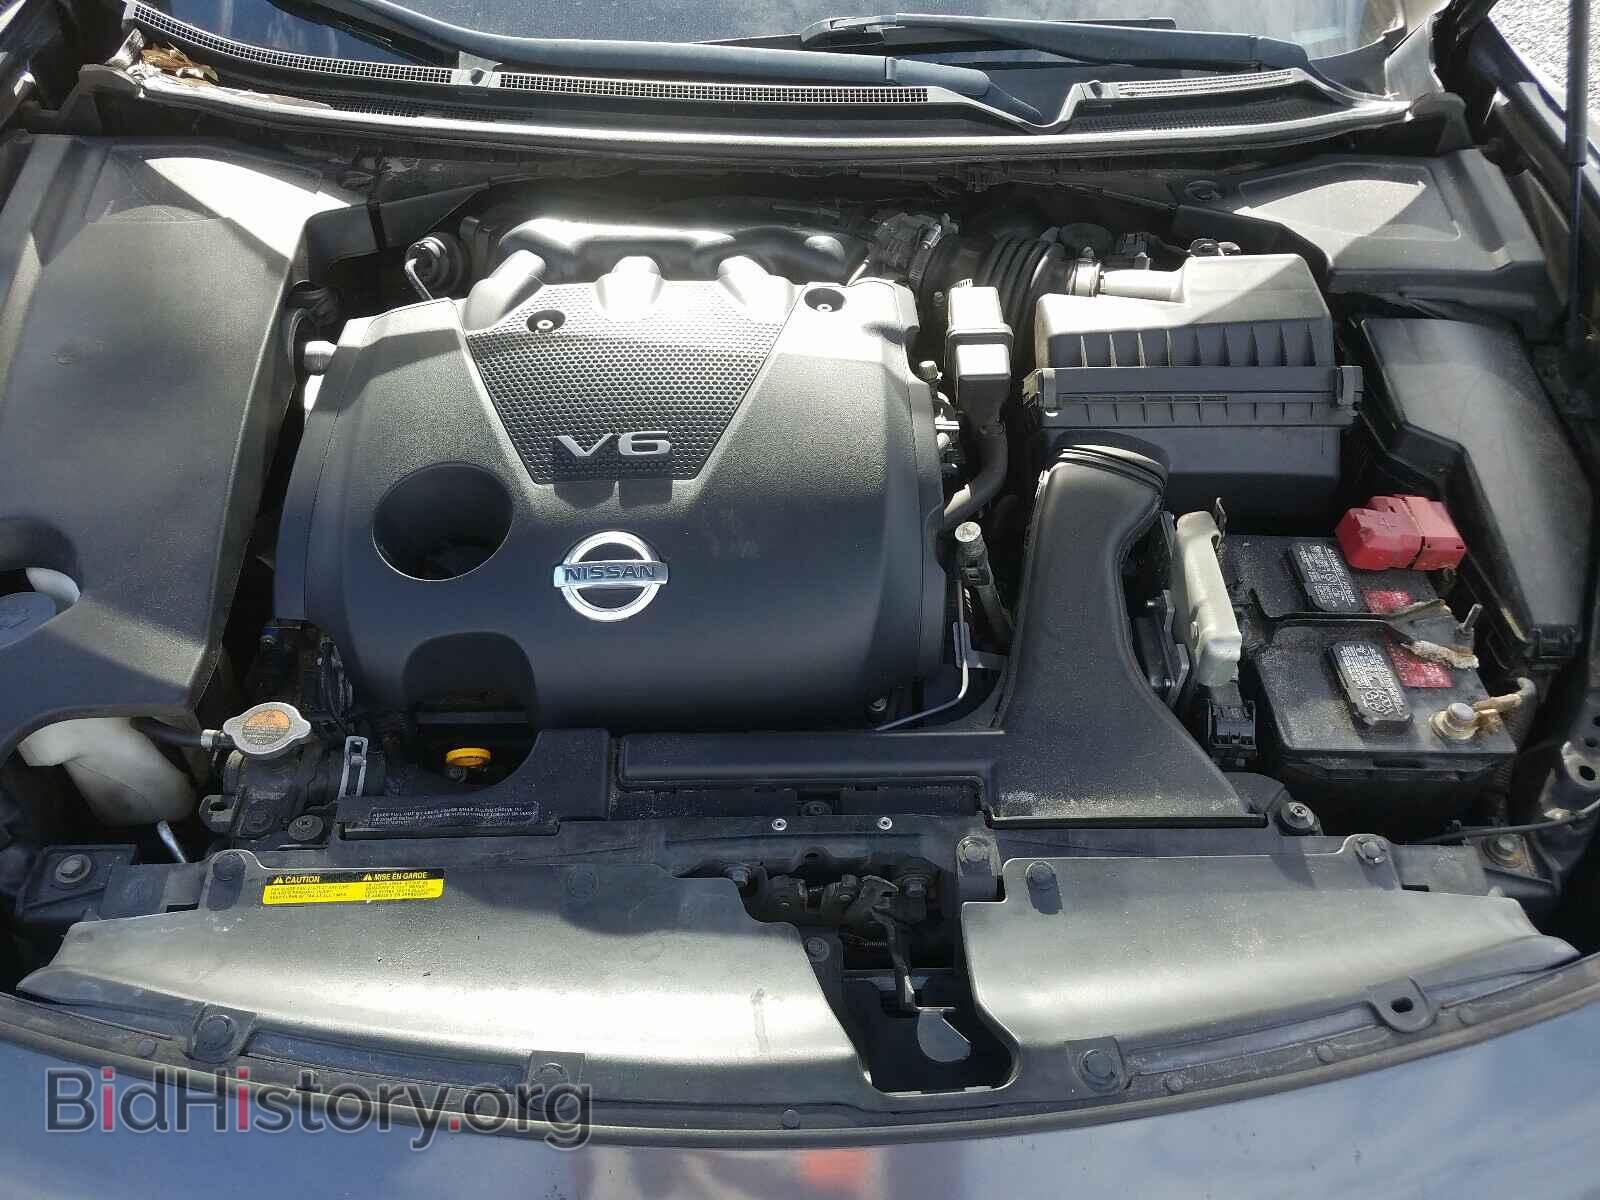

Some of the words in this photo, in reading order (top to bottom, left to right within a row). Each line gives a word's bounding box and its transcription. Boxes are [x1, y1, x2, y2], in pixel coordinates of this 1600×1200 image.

[555, 430, 671, 457] V6
[564, 564, 656, 581] NISSAN
[285, 875, 320, 884] CAUTION
[374, 873, 391, 881] MISE
[402, 871, 427, 880] GARDE
